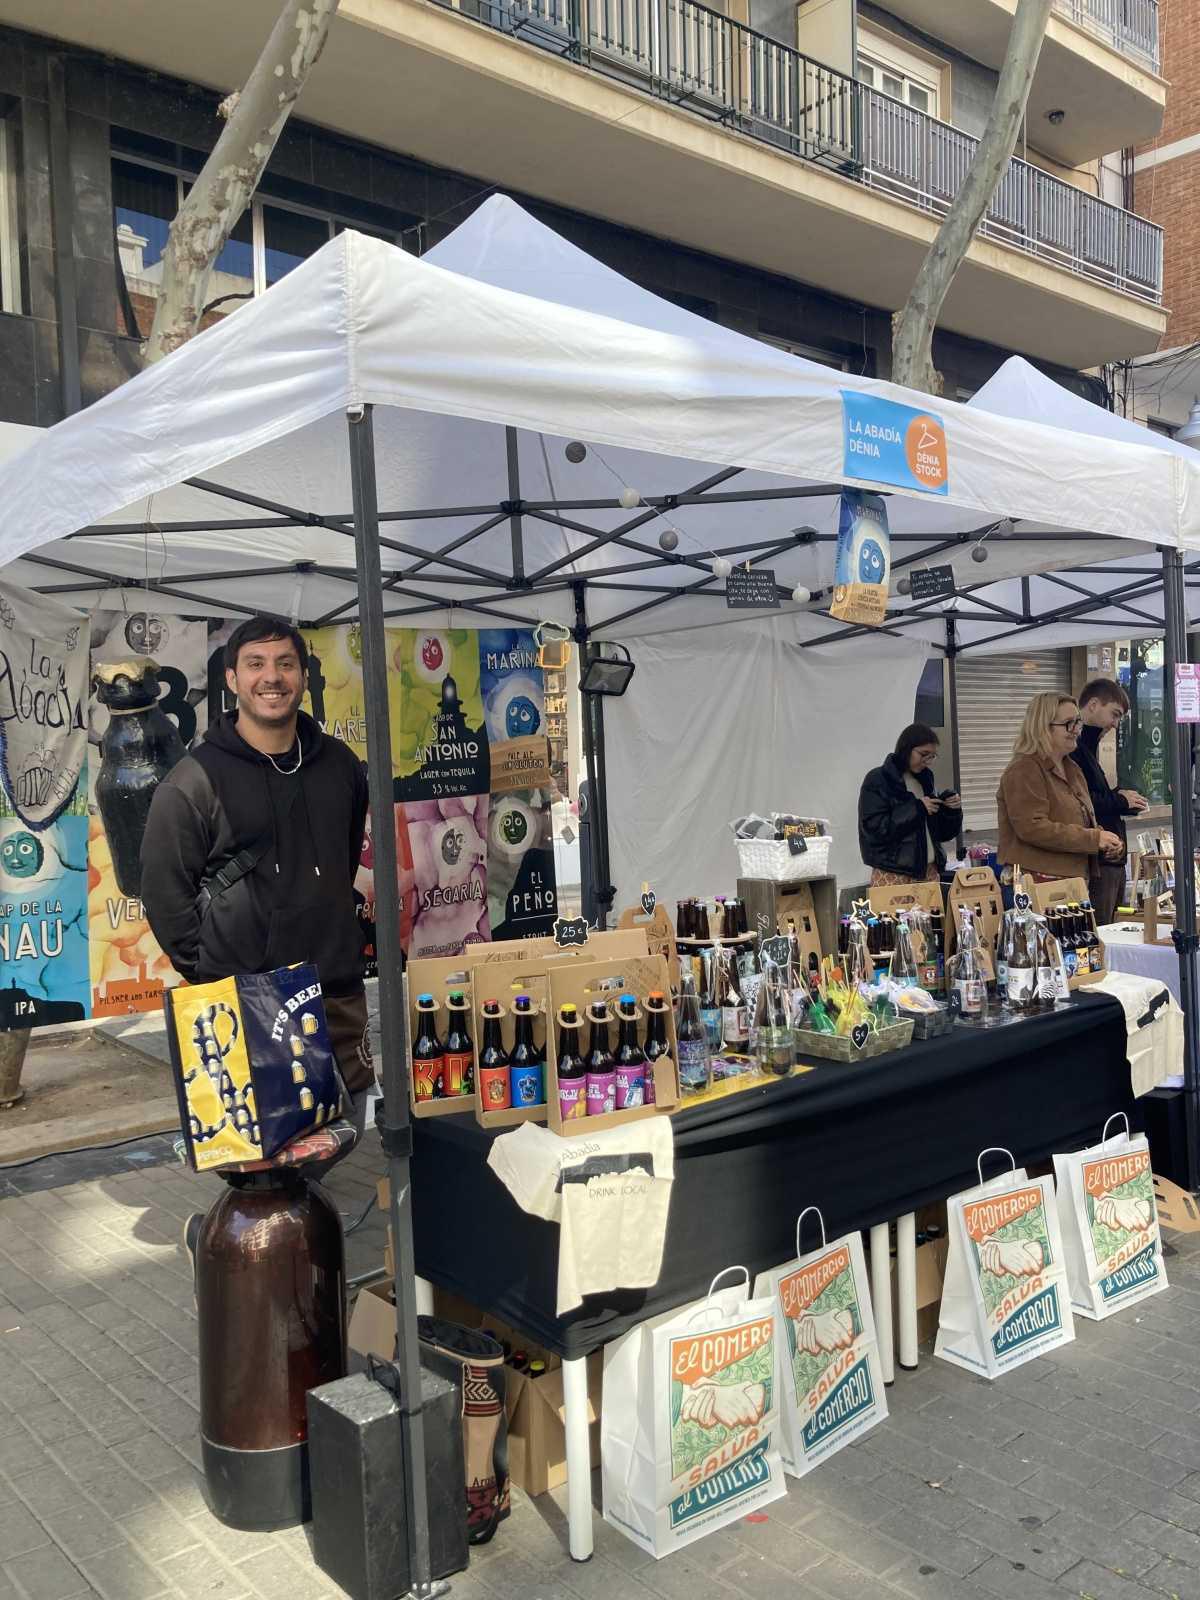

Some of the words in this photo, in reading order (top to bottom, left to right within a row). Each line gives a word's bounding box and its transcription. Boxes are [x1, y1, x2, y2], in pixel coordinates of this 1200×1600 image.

[849, 418, 862, 433] LA
[864, 423, 902, 444] ABADÍA
[849, 438, 881, 458] DÉNIA
[915, 463, 942, 478] STOCK
[30, 638, 50, 678] La
[431, 722, 457, 741] SAN
[414, 741, 479, 762] ANTONIO
[450, 768, 476, 777] TEQUILA
[20, 902, 40, 916] DE
[45, 899, 63, 914] LA
[423, 879, 484, 912] SEGARIA
[15, 1000, 37, 1017] IPA
[99, 993, 130, 1005] PILSNER
[272, 1009, 289, 1042] IT'S
[589, 1186, 616, 1199] DRINK
[621, 1183, 648, 1196] LOCAL
[1088, 1167, 1101, 1190] El
[967, 1206, 980, 1235] El
[978, 1193, 1037, 1233] COMERCIO
[1108, 1233, 1150, 1272] SALVA
[783, 1279, 798, 1312] El
[796, 1254, 845, 1307] COMERCIO
[995, 1276, 1044, 1322] SALVA
[1005, 1294, 1055, 1342] COMERCIO
[675, 1341, 700, 1375] El
[808, 1350, 856, 1411] SALVA
[818, 1367, 869, 1430] COMERCIO
[688, 1427, 759, 1486] SALVA
